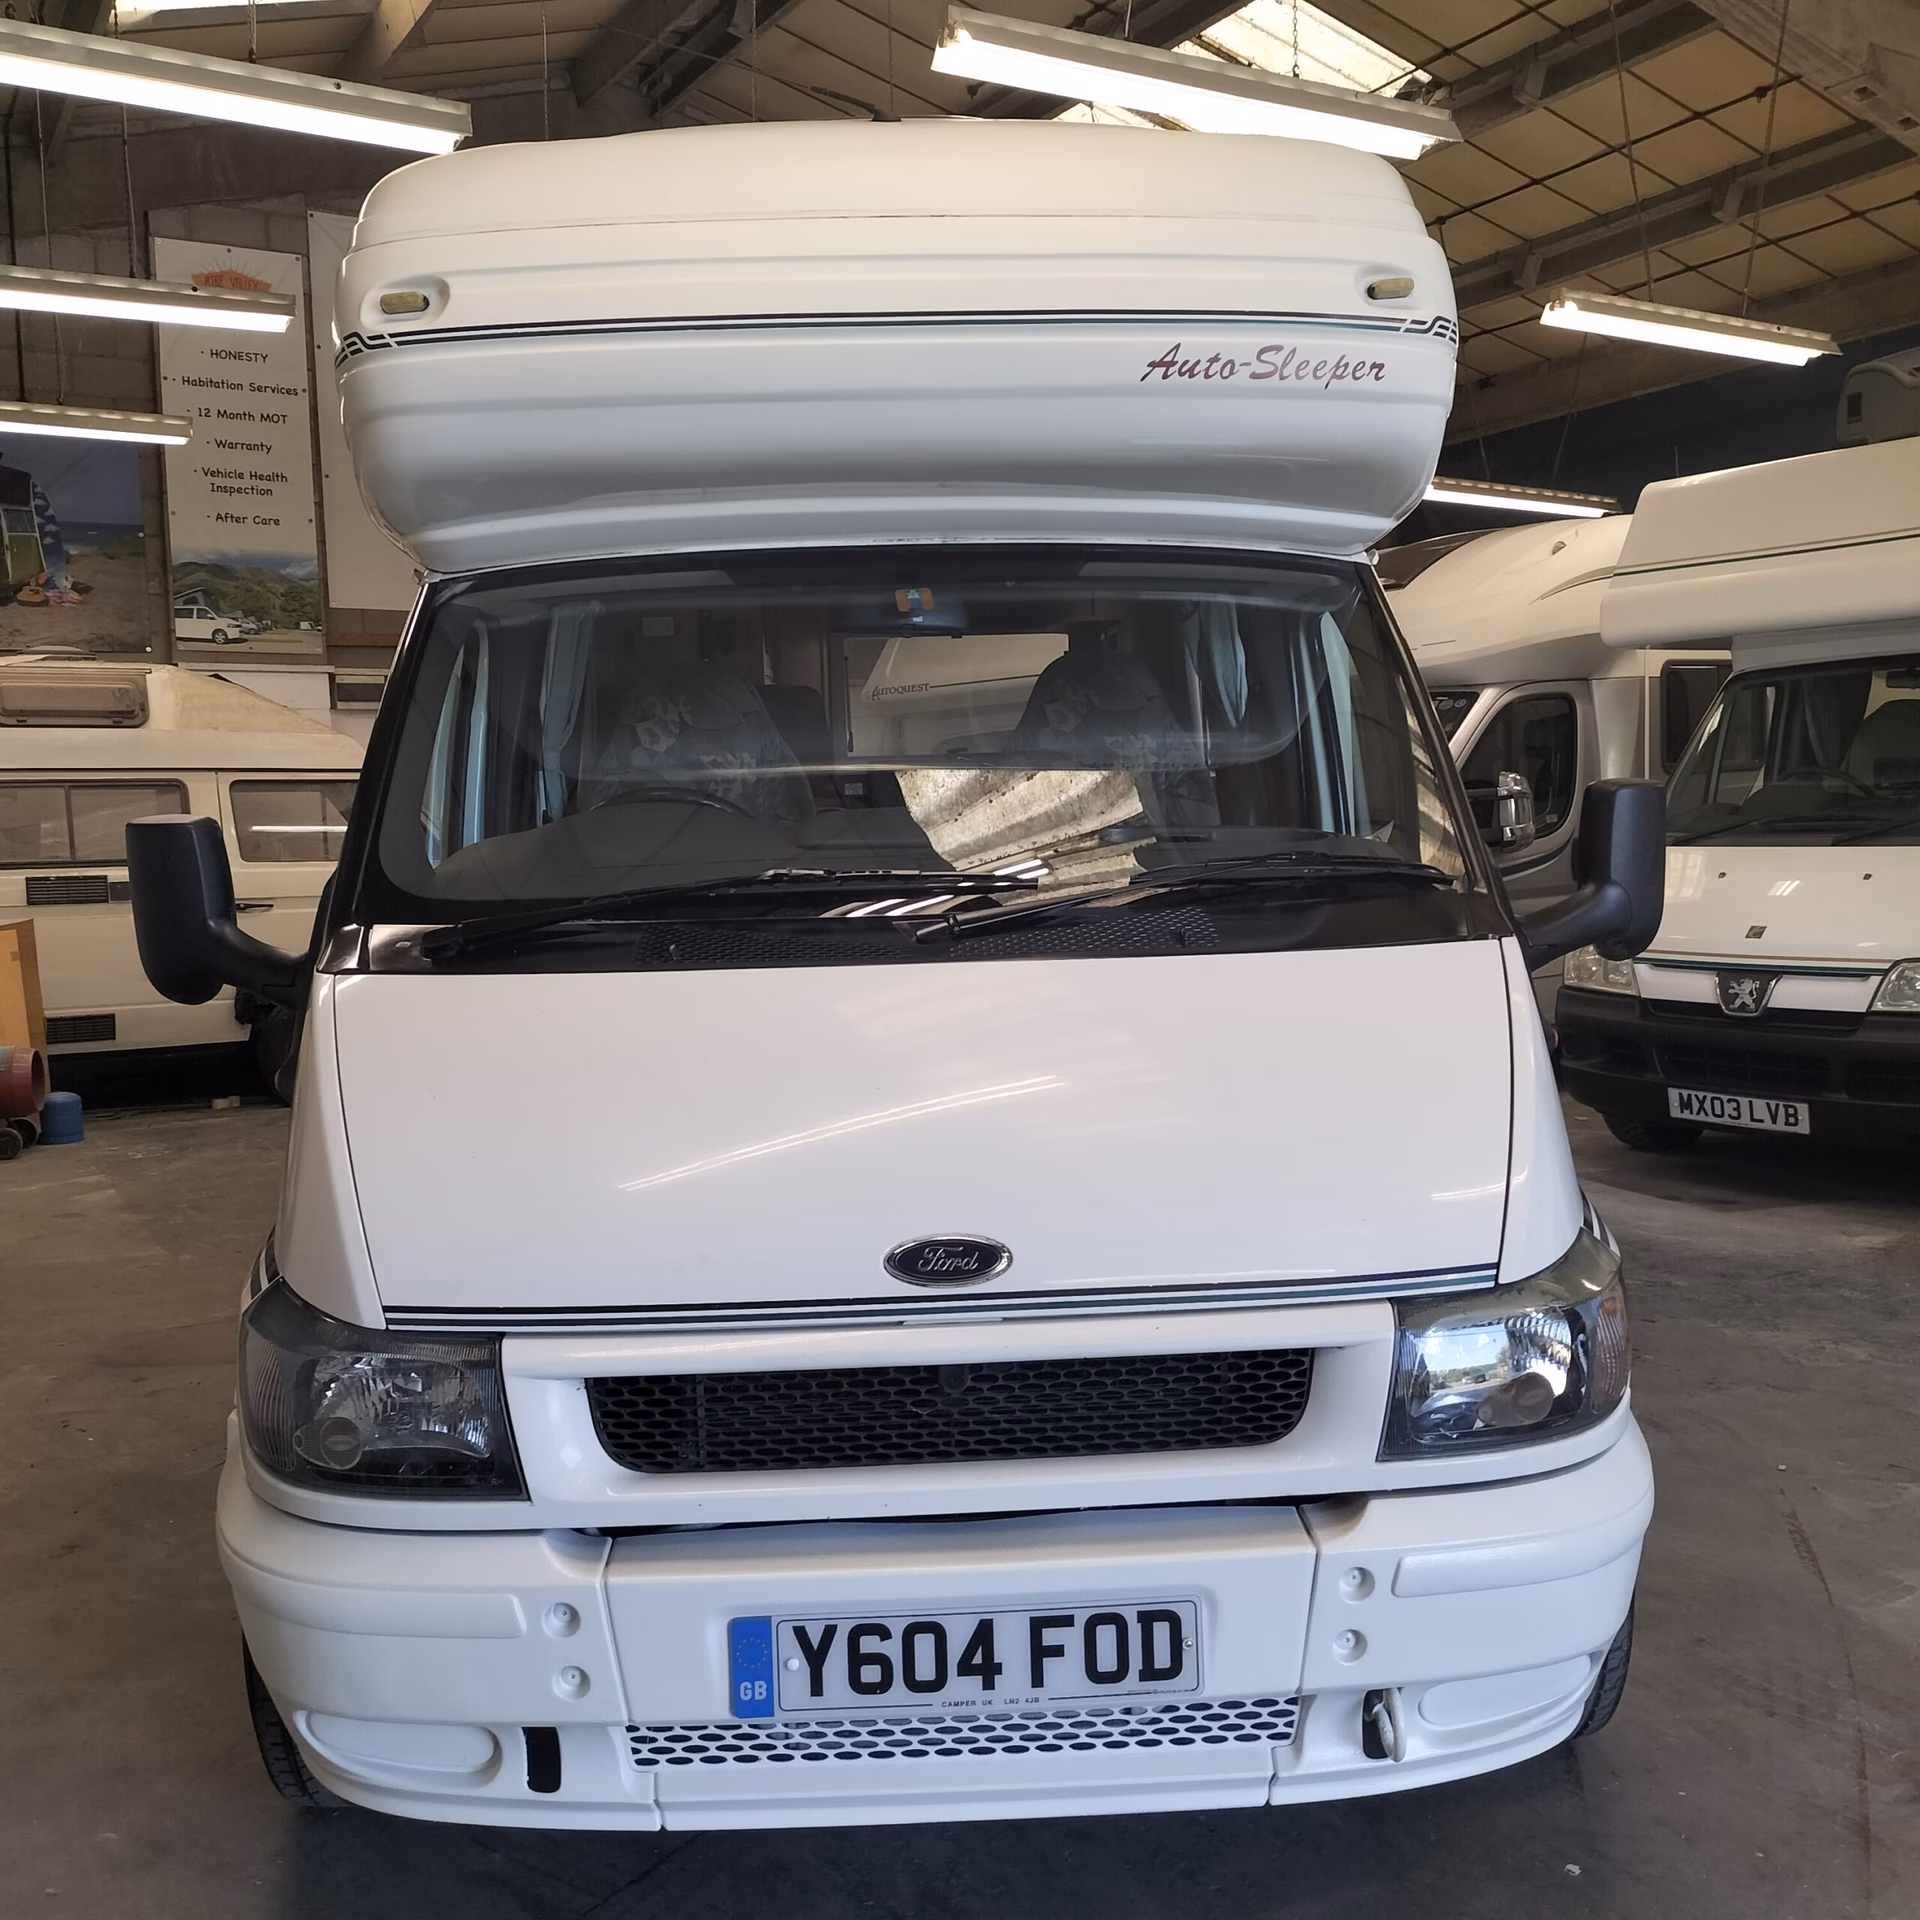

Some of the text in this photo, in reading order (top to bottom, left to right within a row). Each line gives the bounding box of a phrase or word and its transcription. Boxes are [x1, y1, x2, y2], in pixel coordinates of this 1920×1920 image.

[210, 348, 269, 364] HONESTY
[1139, 342, 1386, 390] Auto-Sleeper
[182, 375, 299, 396] Habitation Services
[197, 407, 288, 424] 12 Month MOT
[214, 438, 273, 455] Warranty
[201, 466, 288, 483] Vehicle Health
[209, 482, 273, 497] Inspection
[215, 512, 281, 526] After Care
[1677, 1091, 1800, 1127] MX03 LVB
[917, 1246, 980, 1272] Ford
[792, 1608, 1184, 1699] Y604 FOD
[739, 1680, 768, 1701] GB
[941, 1699, 977, 1708] CAMPER
